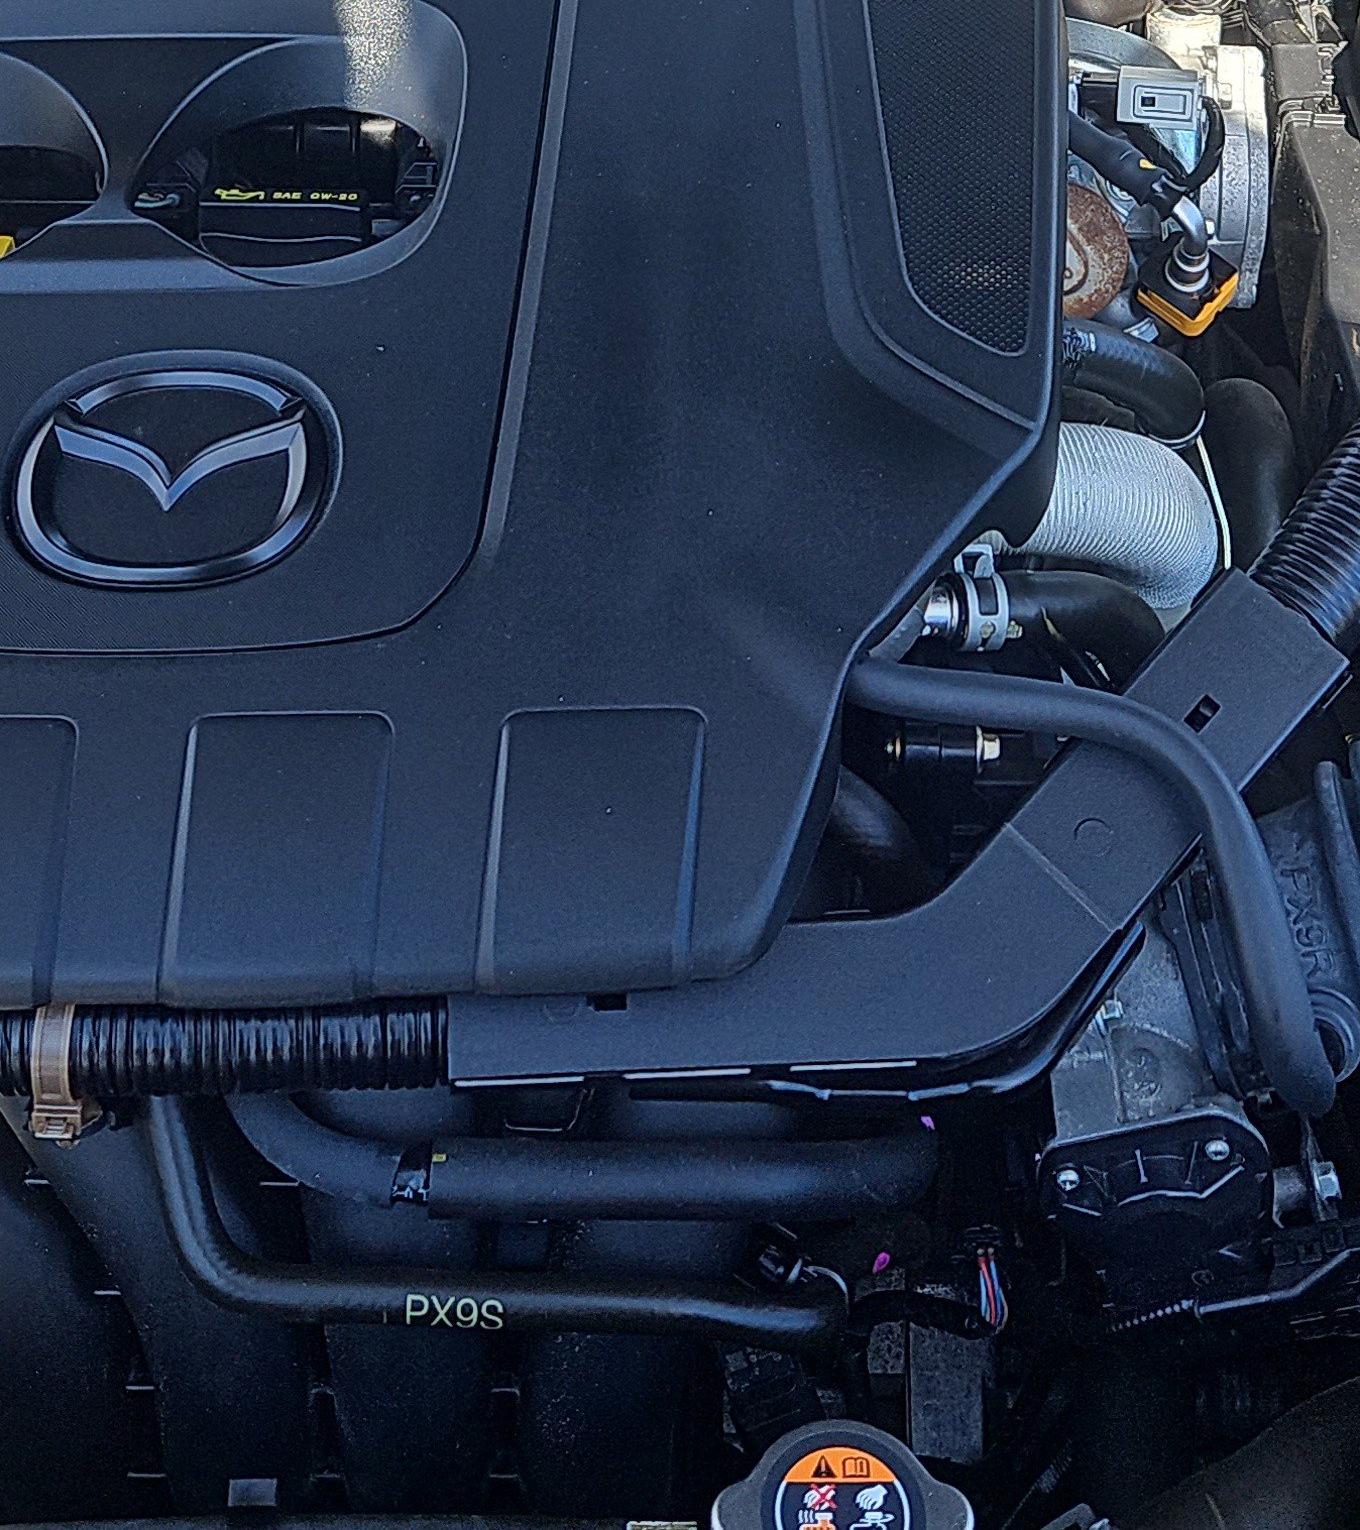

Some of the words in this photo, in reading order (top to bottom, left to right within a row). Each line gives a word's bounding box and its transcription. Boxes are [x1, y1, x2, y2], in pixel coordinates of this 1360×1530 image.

[272, 192, 303, 200] SAE
[310, 192, 358, 201] 0W-20
[1279, 866, 1335, 979] PX9R
[405, 1293, 504, 1330] PX9S
